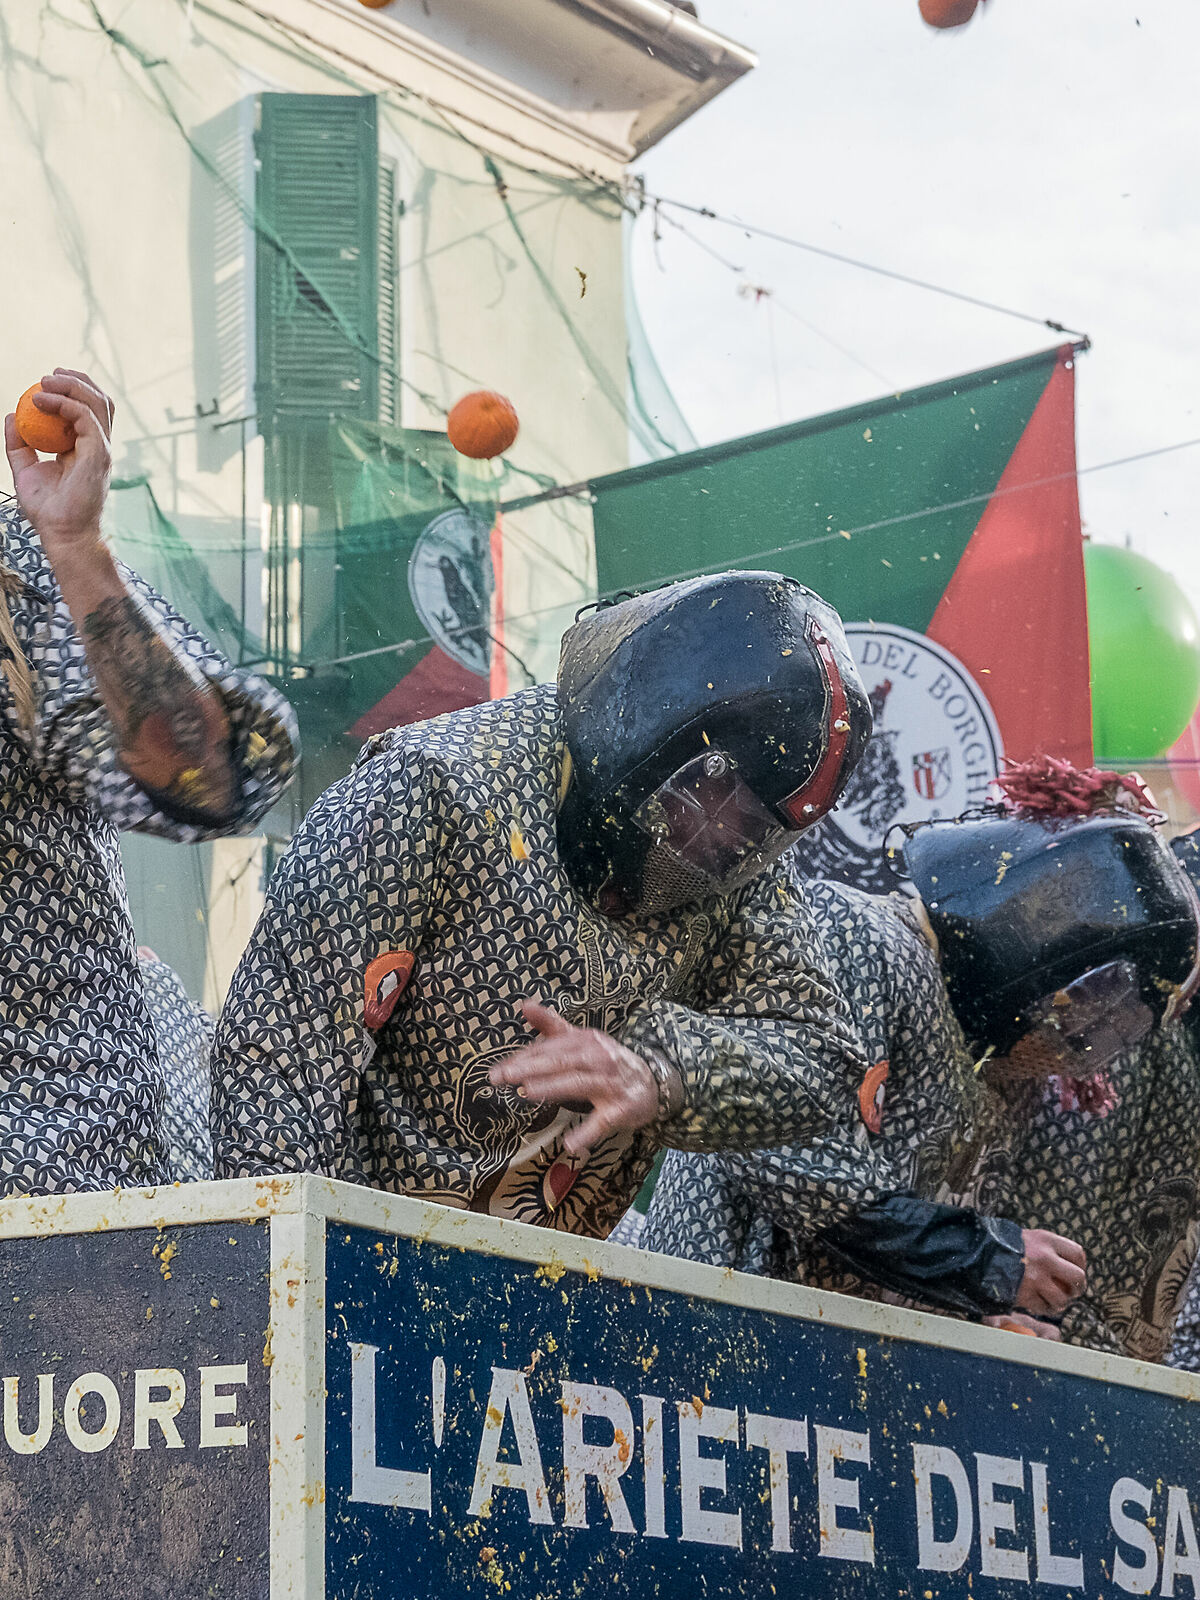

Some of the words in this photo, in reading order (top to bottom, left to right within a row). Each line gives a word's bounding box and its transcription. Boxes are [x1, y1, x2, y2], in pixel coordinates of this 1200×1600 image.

[860, 640, 918, 679] DEL
[346, 1341, 875, 1566] L'ARIETE
[910, 1441, 1084, 1592] DEL
[1109, 1476, 1200, 1600] SA
